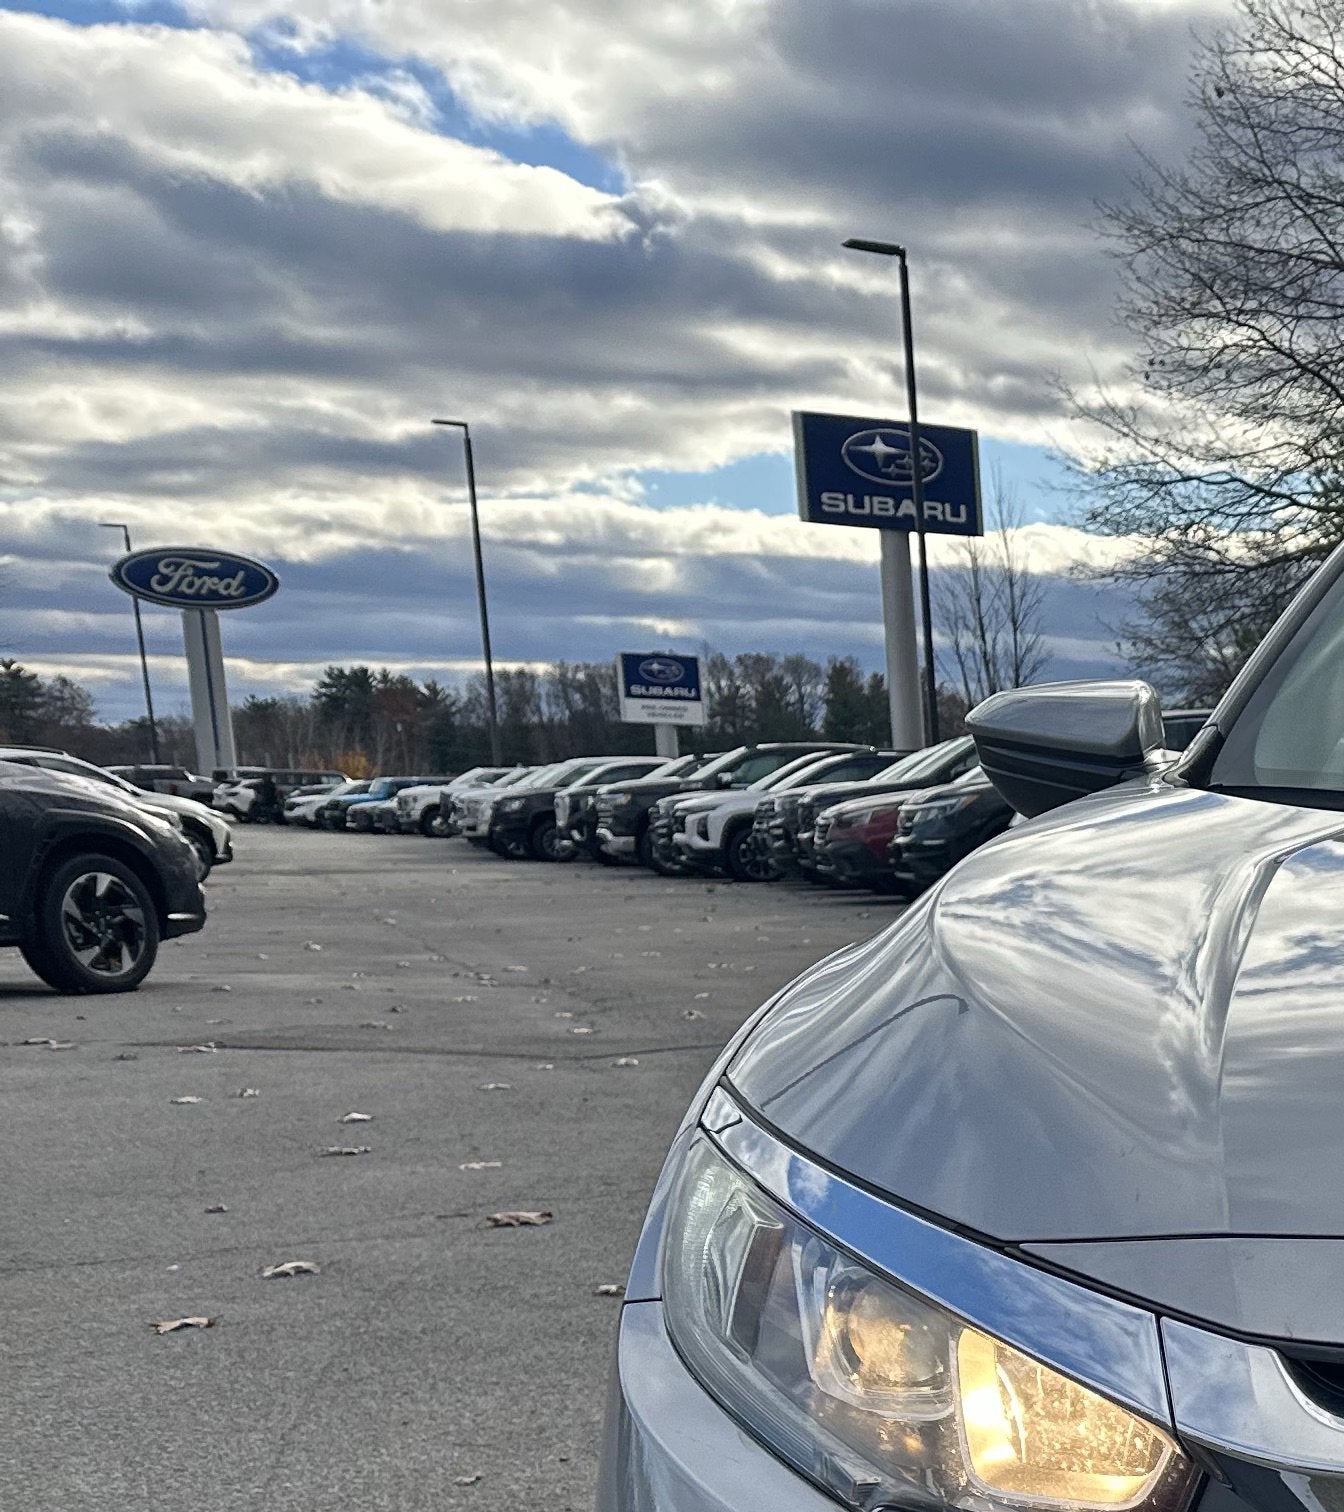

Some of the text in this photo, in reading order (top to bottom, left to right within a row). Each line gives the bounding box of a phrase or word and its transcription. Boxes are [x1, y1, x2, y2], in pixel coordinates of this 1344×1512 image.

[820, 491, 967, 524] SUBARU
[150, 557, 246, 596] Ford
[629, 684, 698, 698] SUBARU
